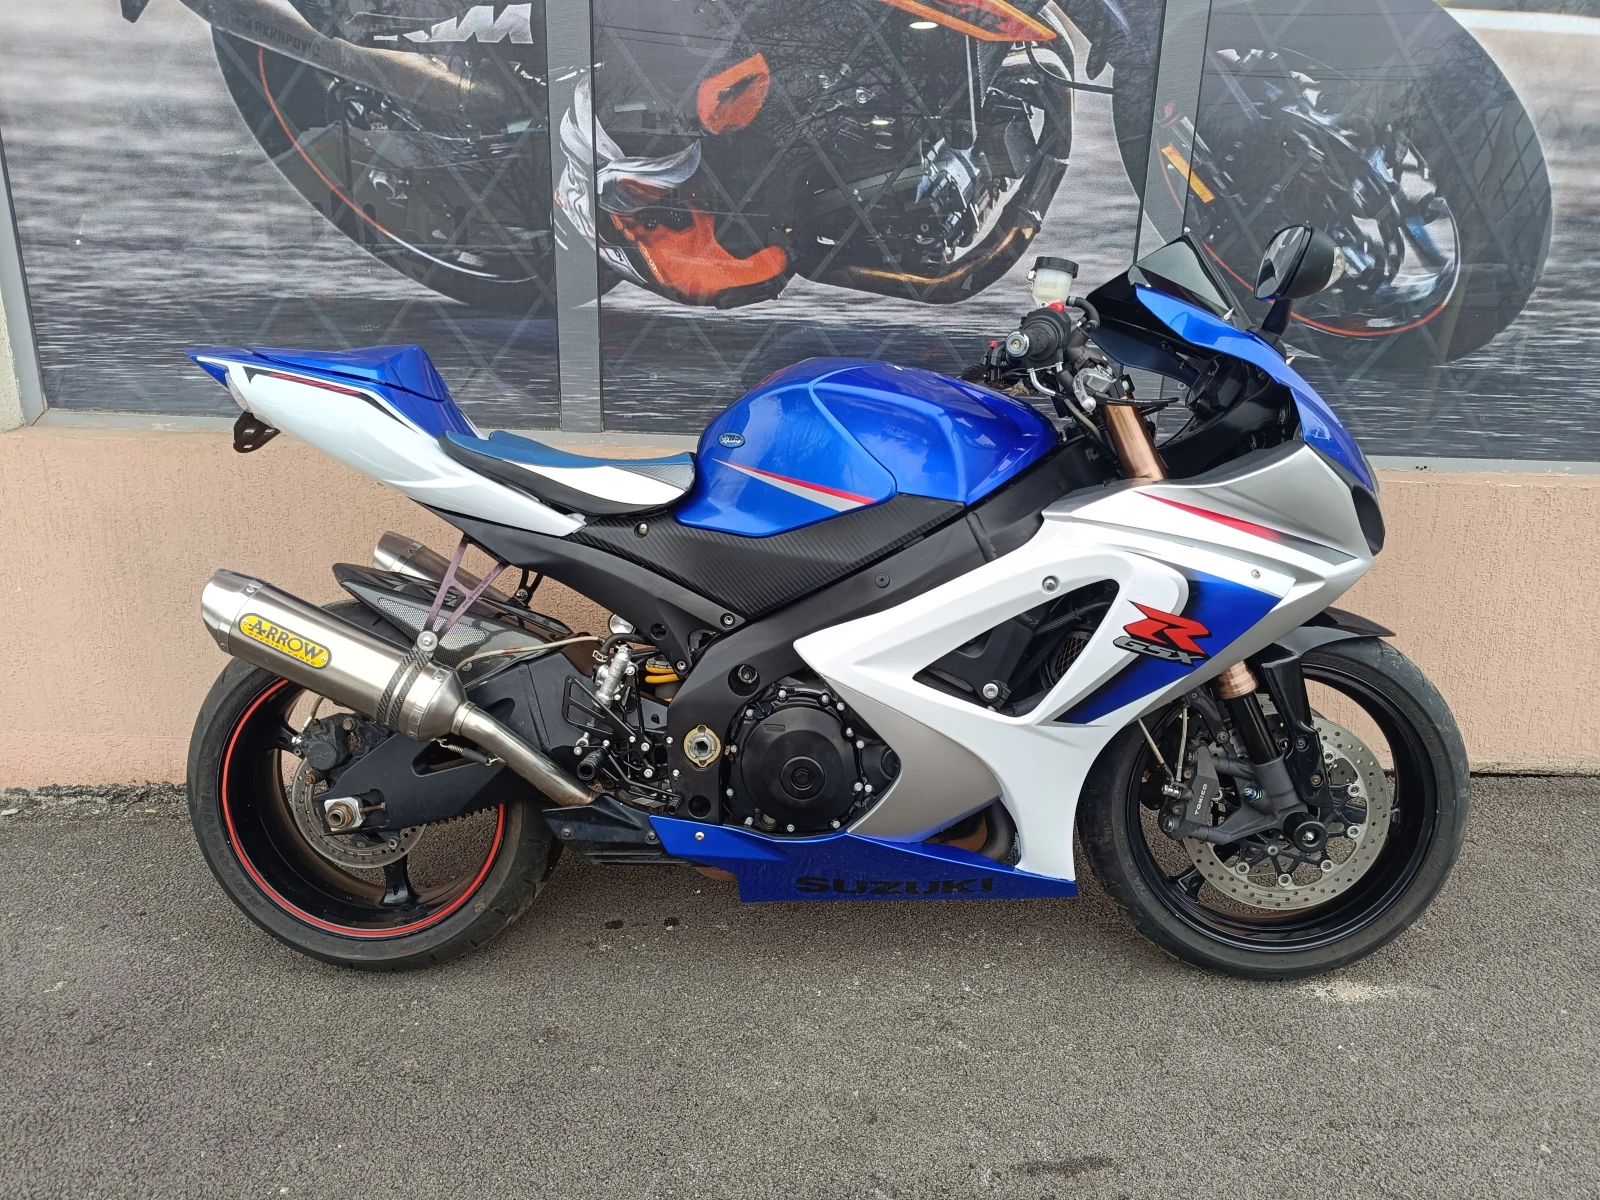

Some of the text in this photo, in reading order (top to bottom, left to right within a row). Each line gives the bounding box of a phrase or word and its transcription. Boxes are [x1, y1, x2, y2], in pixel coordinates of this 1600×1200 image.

[248, 619, 325, 660] ARROW
[1194, 783, 1208, 816] TOKICO
[795, 875, 994, 895] SUZUKI
